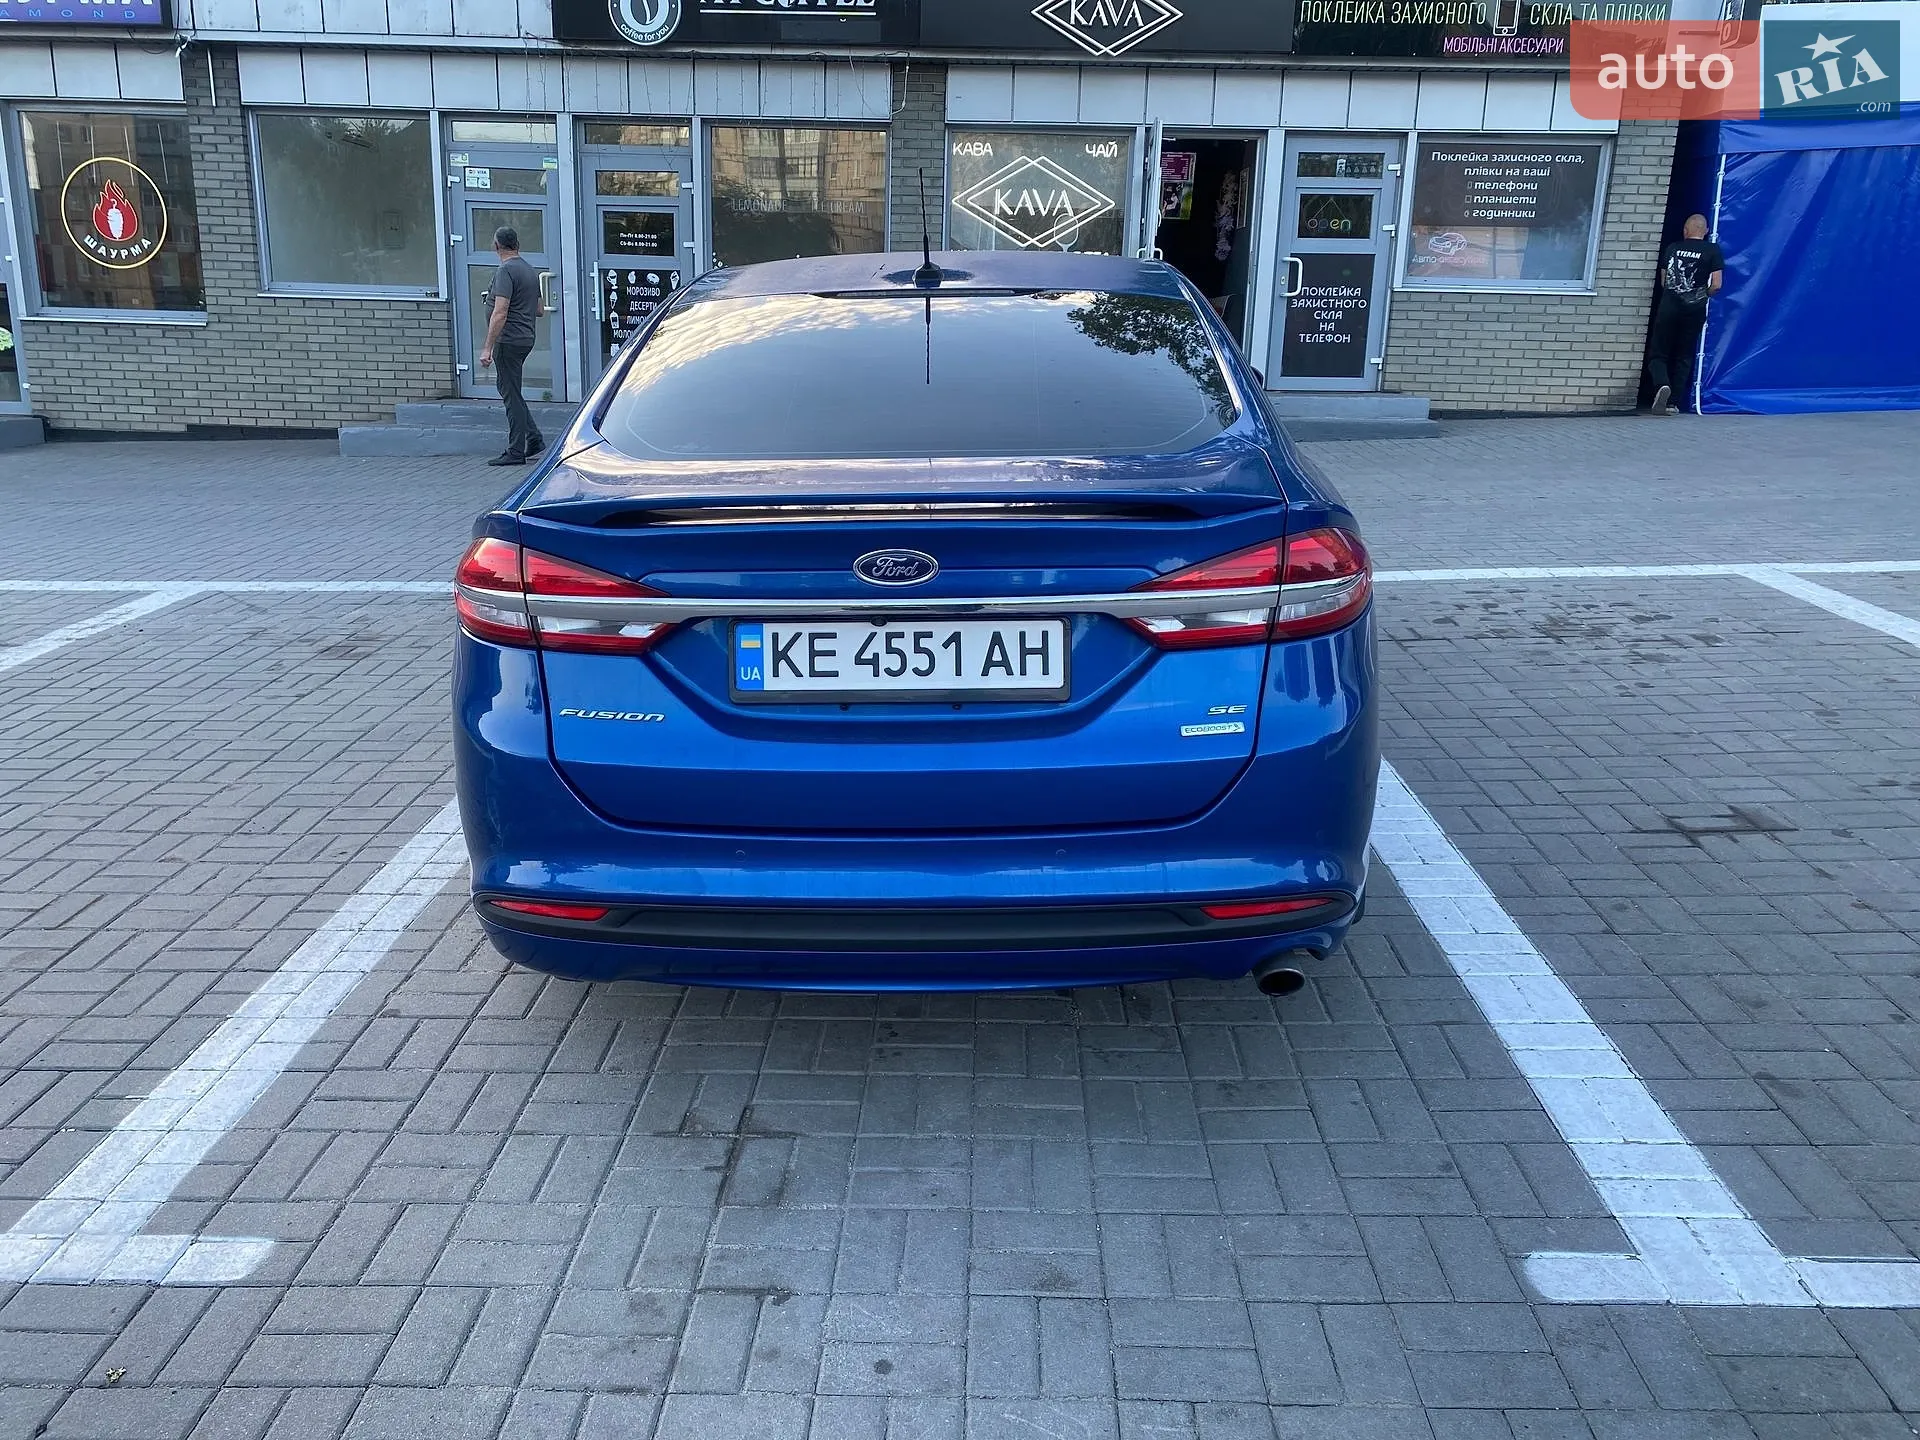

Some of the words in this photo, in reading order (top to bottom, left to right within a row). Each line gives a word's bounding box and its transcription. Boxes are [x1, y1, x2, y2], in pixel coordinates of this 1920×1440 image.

[1069, 0, 1145, 27] KAVA
[1391, 1, 1487, 25] ЗАХИСНОГО
[1530, 3, 1573, 26] СКЛА
[1580, 3, 1598, 26] ТА
[1604, 3, 1667, 27] ПЛІВКИ
[620, 23, 644, 41] coffee
[644, 32, 656, 41] for
[656, 24, 670, 40] you
[1443, 36, 1498, 53] МОБІЛЬНІ
[1499, 37, 1565, 54] АКСЕСУАРИ
[952, 142, 994, 157] КАВА
[1085, 141, 1118, 158] ЧАЙ
[1431, 151, 1489, 163] Поклейка
[1491, 154, 1552, 163] захисного
[1555, 154, 1585, 164] скла,
[1464, 166, 1503, 177] плівки
[1505, 169, 1520, 177] на
[1523, 167, 1551, 177] ваші
[1474, 180, 1538, 192] телефони
[994, 188, 1074, 217] KAVA
[1473, 195, 1537, 205] планшети
[1472, 209, 1536, 220] годинники
[83, 234, 152, 259] ШАУРМА
[626, 287, 660, 297] МОРОЗИВО
[1301, 286, 1361, 296] ПОКЛЕЙКА
[1290, 299, 1367, 308] ЗАХИСТНОГО
[1313, 311, 1343, 320] СКЛА
[1319, 322, 1335, 331] НА
[1298, 333, 1351, 343] ТЕЛЕФОН
[872, 556, 918, 577] Ford
[772, 631, 839, 678] KE
[854, 630, 962, 678] 4551
[981, 630, 1050, 677] AH
[741, 668, 761, 681] UA
[559, 708, 665, 722] FUSION
[1207, 704, 1248, 715] SE
